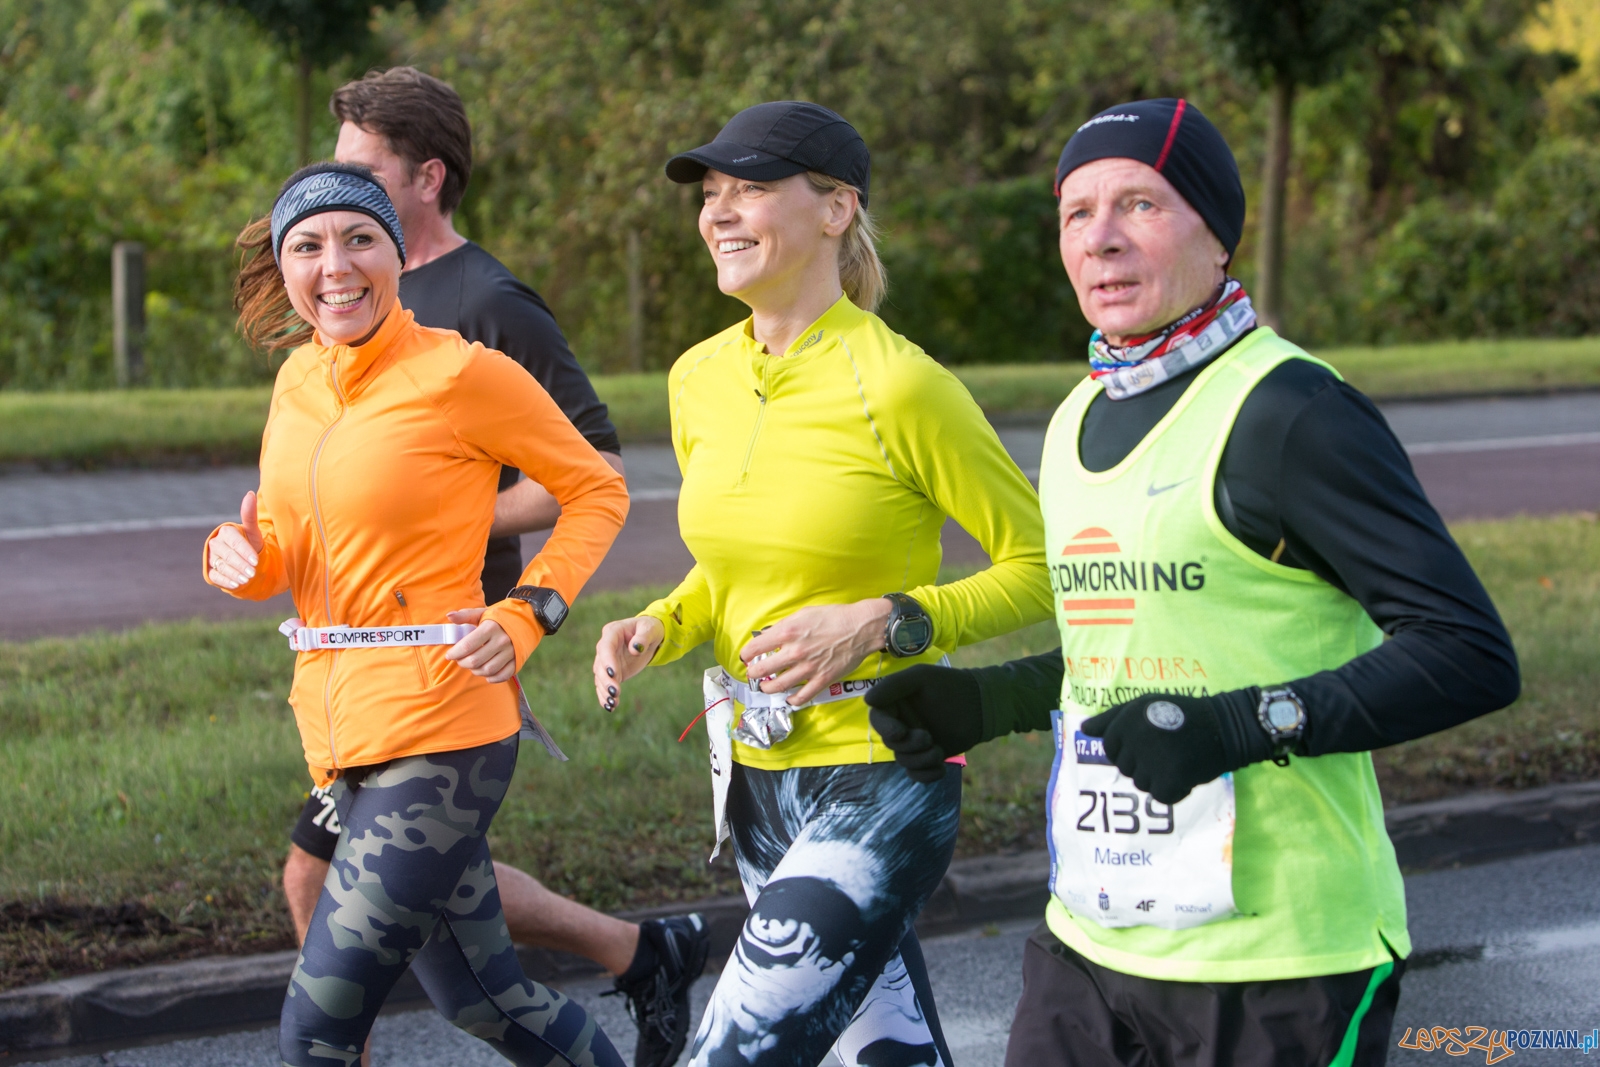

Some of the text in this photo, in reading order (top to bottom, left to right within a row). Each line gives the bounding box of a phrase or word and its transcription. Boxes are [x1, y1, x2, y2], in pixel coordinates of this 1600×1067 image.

[312, 178, 341, 189] RUN
[1050, 561, 1205, 593] ODMORNING
[1124, 656, 1208, 681] DOBRA
[1075, 739, 1090, 756] 17.
[1076, 790, 1175, 835] 2139
[1094, 847, 1153, 866] Marek
